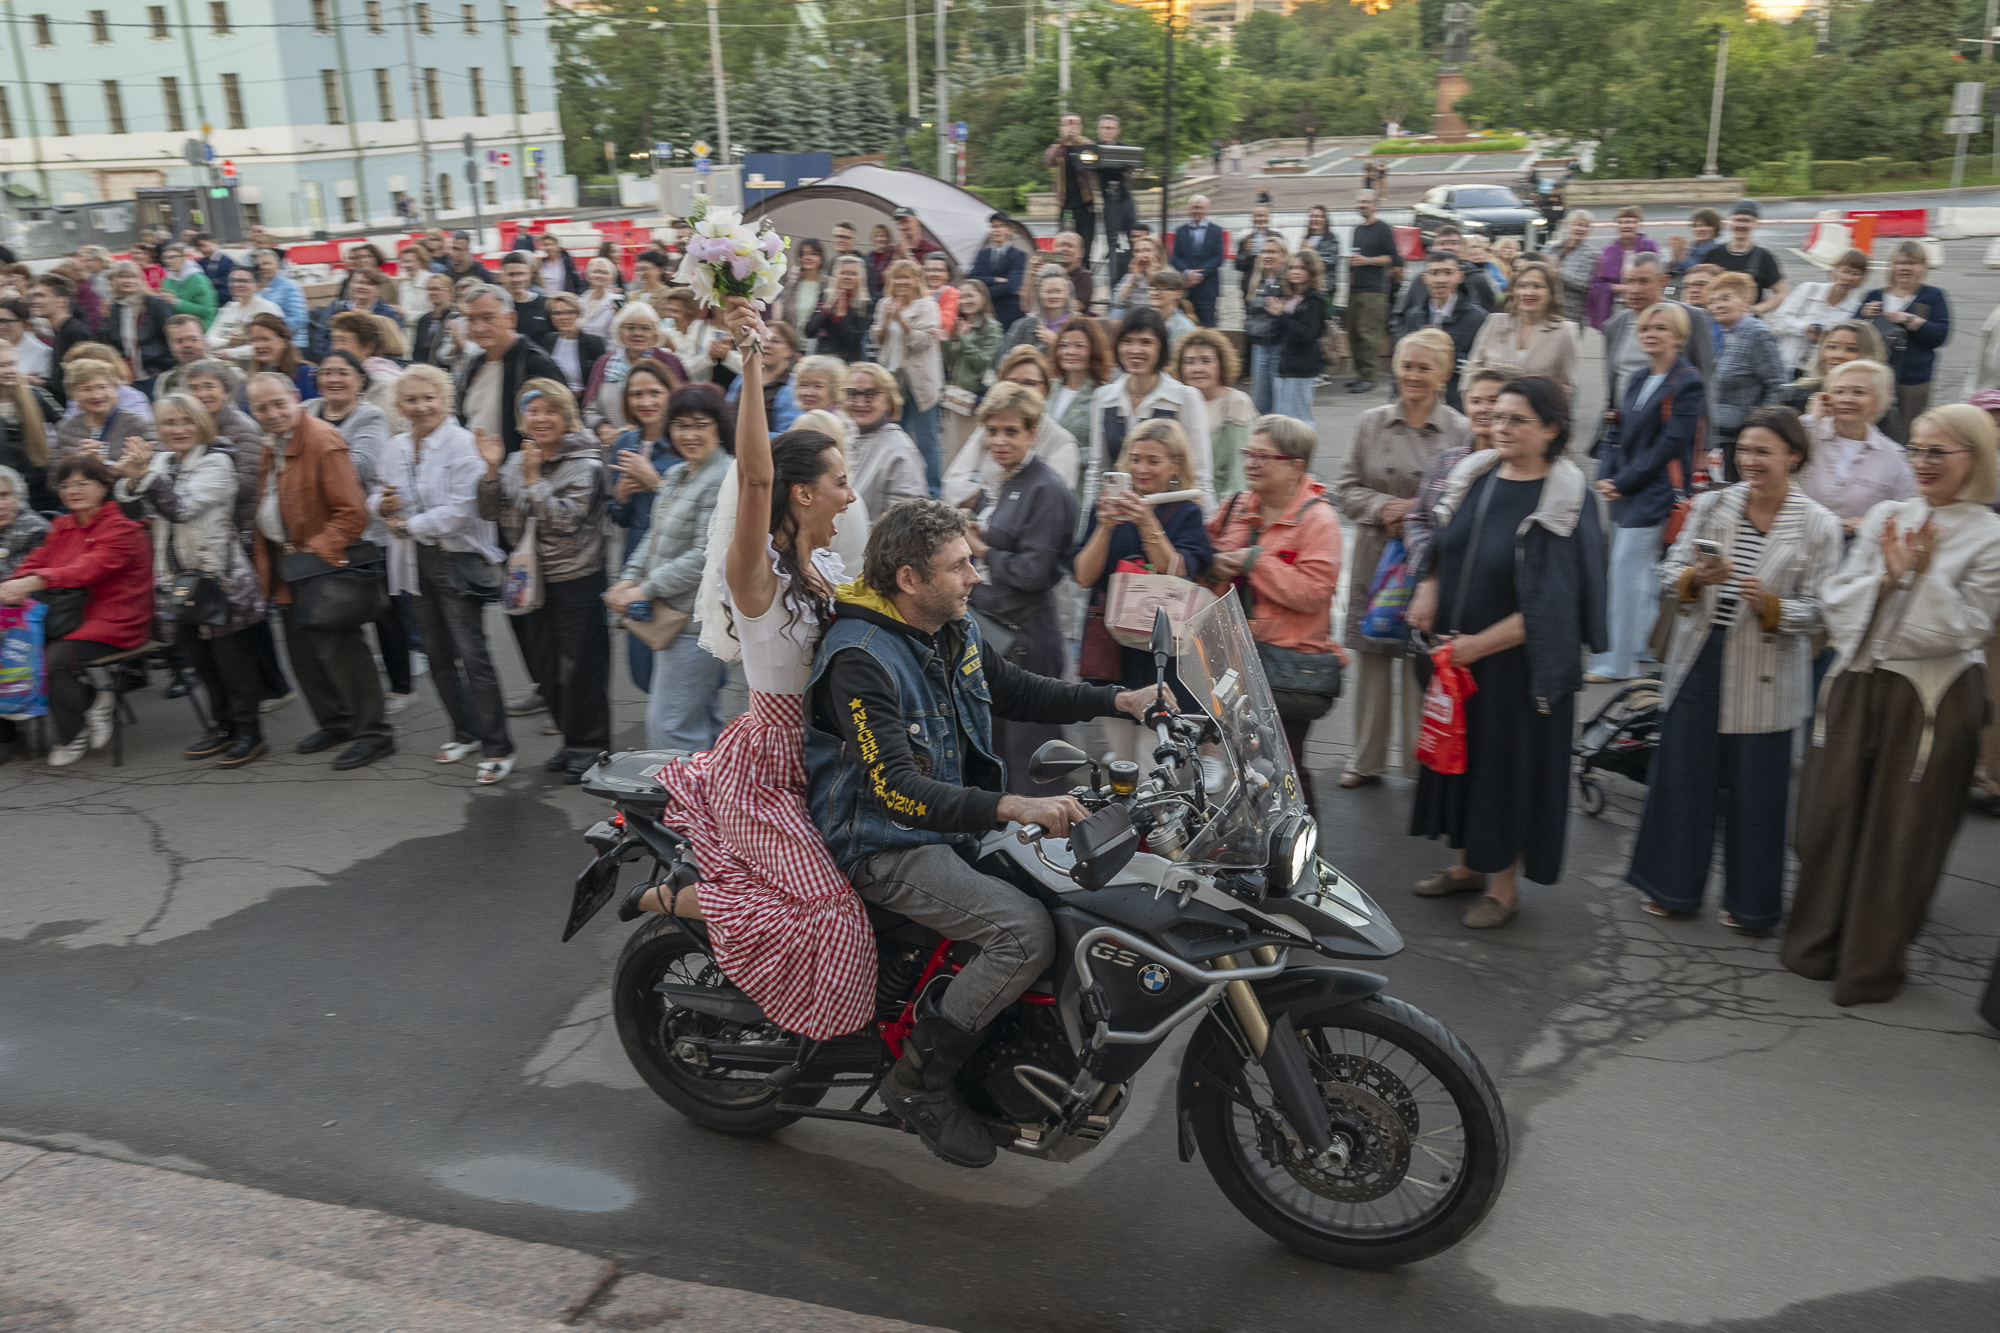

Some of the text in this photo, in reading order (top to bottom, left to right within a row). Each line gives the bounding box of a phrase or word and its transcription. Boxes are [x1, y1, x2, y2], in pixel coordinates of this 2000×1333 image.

[852, 708, 880, 764] NIGHT
[1262, 929, 1291, 939] BMW
[1091, 942, 1140, 967] GS
[1143, 965, 1170, 979] BMW
